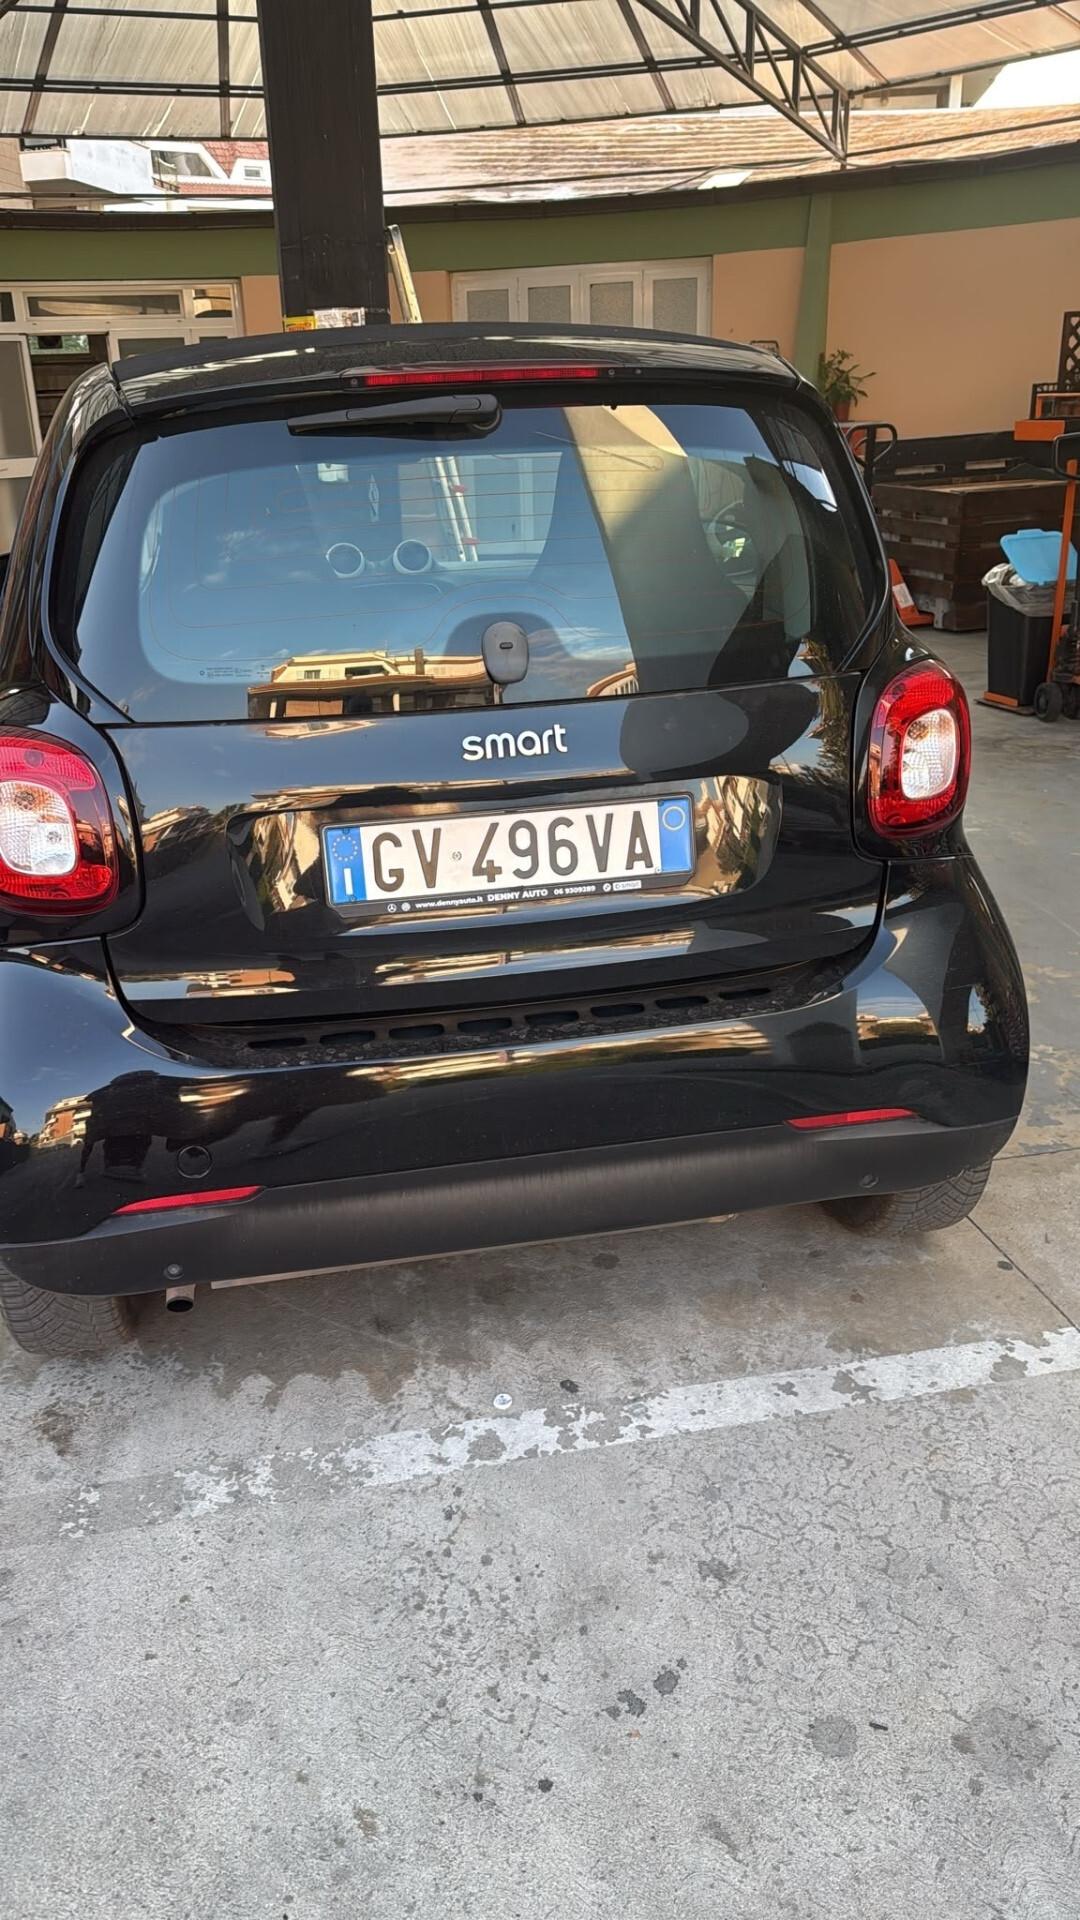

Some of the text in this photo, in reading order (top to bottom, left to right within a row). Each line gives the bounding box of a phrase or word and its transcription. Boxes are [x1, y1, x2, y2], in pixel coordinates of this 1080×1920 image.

[462, 724, 568, 761] smart
[372, 810, 654, 893] GV 496VA
[415, 896, 483, 909] www.dennyauto.it
[487, 891, 520, 902] DENNY
[522, 889, 548, 899] AUTO
[553, 888, 564, 896] 06
